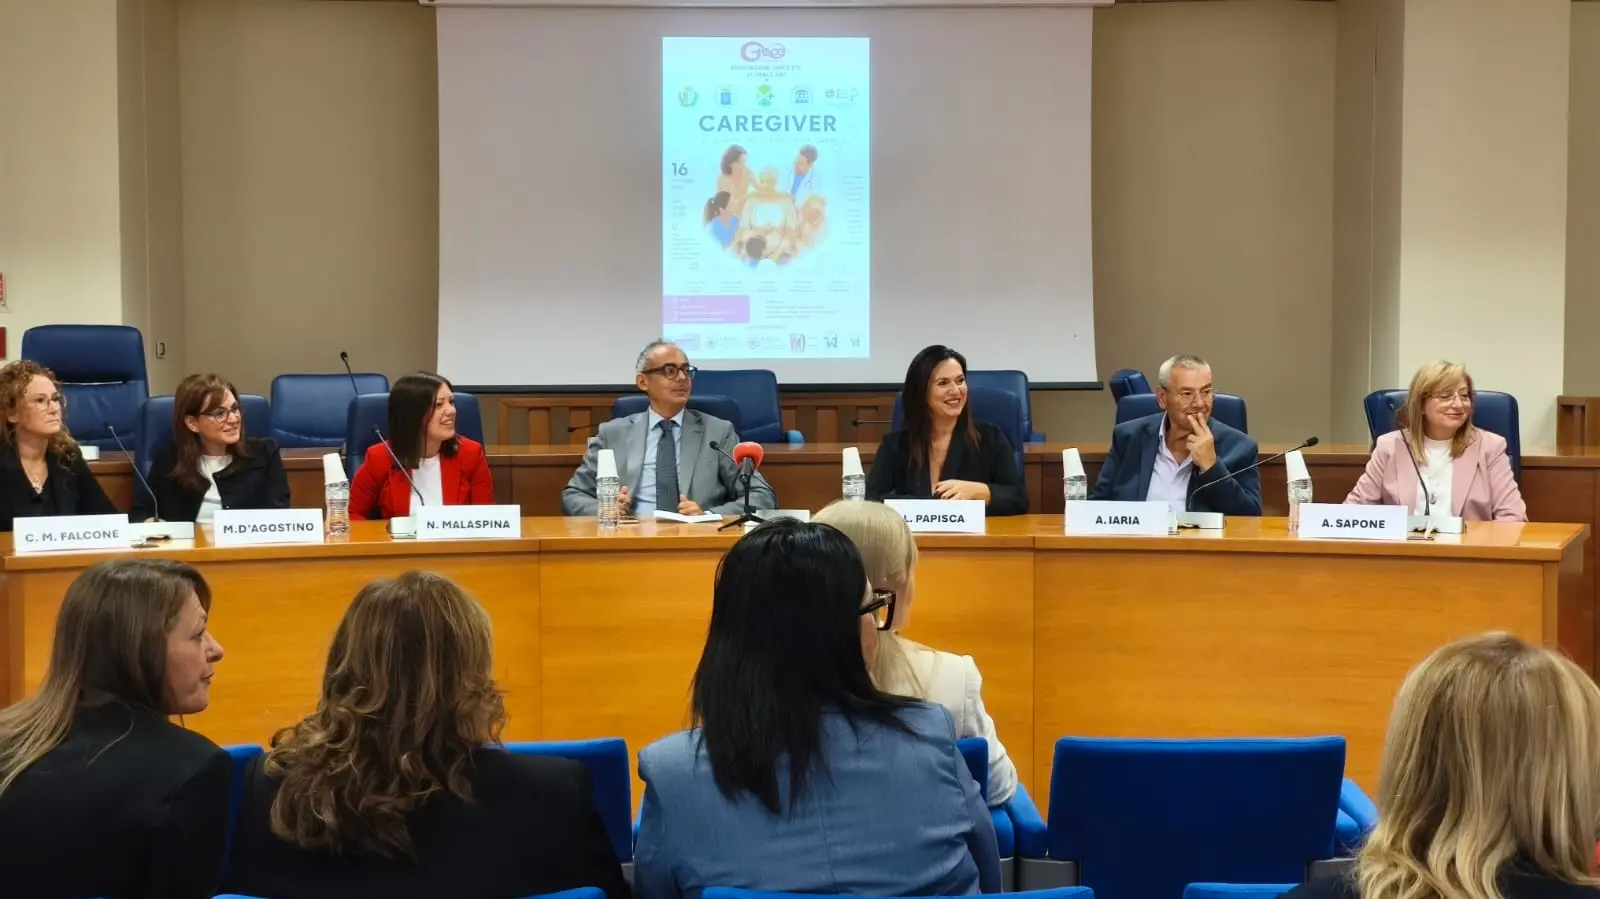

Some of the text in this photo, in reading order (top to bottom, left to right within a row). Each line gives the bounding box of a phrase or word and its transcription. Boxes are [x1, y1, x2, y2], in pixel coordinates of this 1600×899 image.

[699, 115, 837, 132] CAREGIVER
[671, 162, 688, 176] 16
[915, 514, 965, 523] PAPISCA
[1095, 515, 1140, 525] A. IARIA
[1321, 518, 1386, 528] A. SAPONE
[426, 519, 511, 529] N. MALASPINA
[25, 529, 120, 543] C. M. FALCONE
